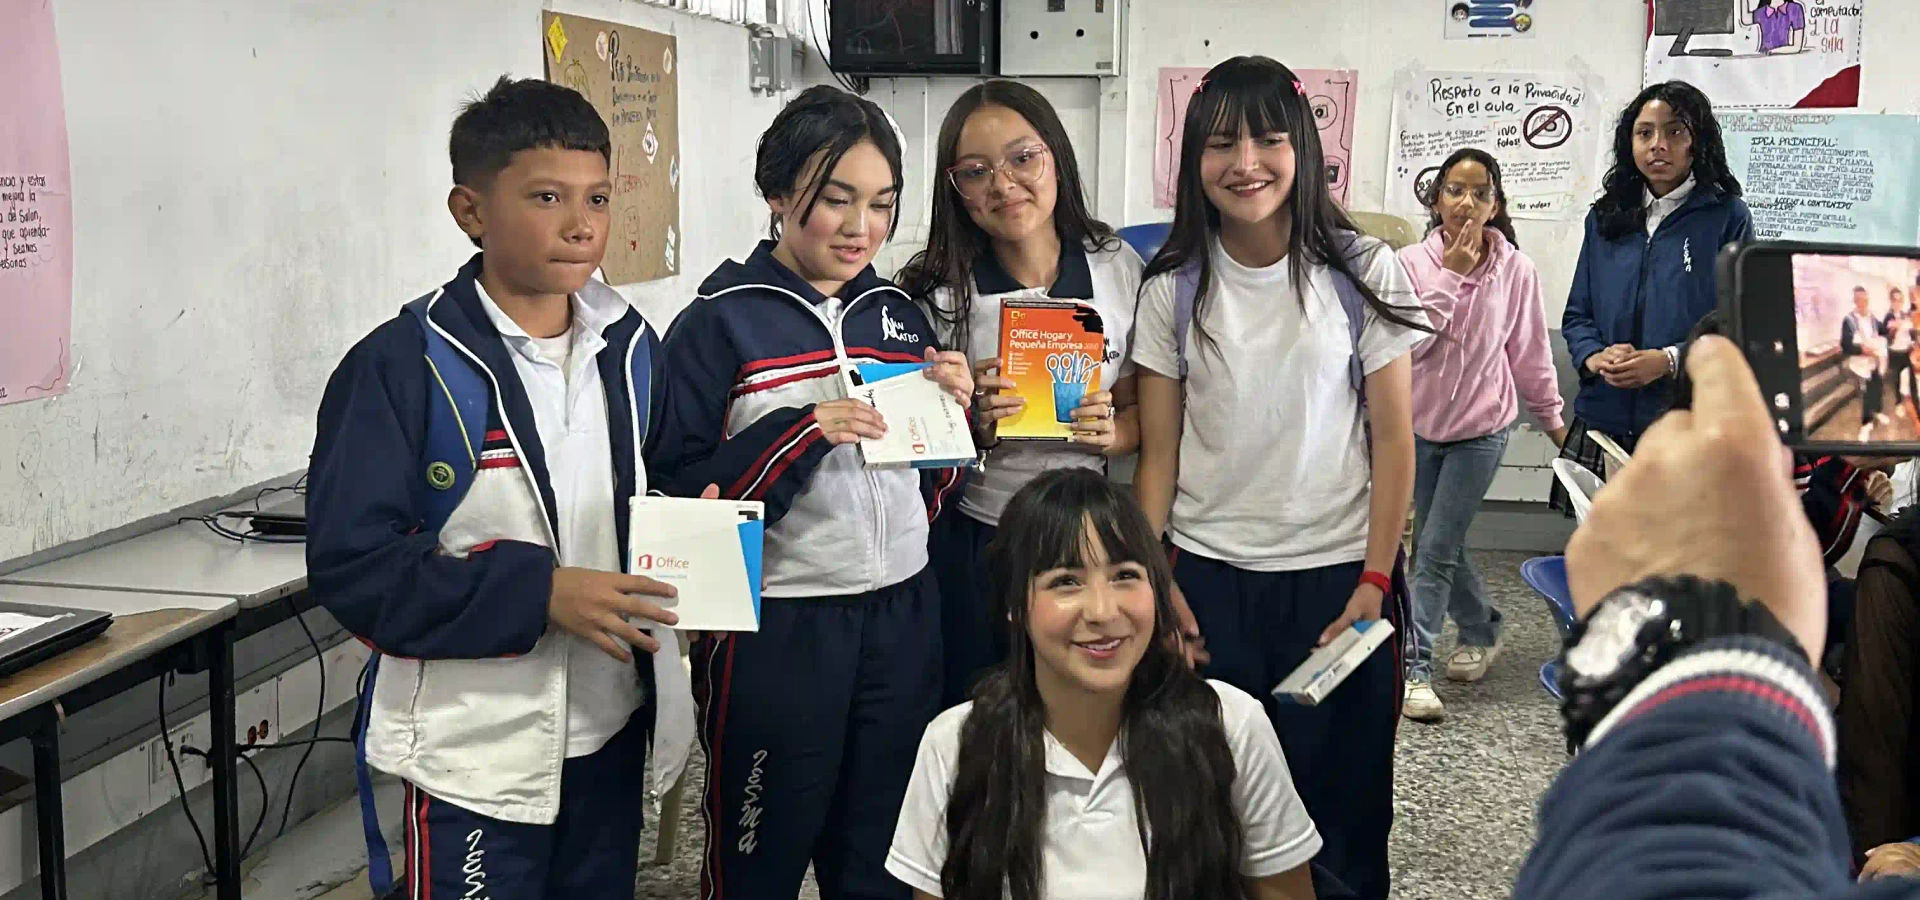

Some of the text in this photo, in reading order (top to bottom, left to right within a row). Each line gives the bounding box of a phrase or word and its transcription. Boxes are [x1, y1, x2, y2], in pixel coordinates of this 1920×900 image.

[1824, 17, 1839, 35] la
[1491, 86, 1500, 97] a
[1509, 84, 1520, 96] la
[1446, 100, 1514, 116] En el aula
[1751, 136, 1775, 146] IDEA
[29, 189, 36, 202] la
[1807, 199, 1853, 210] CONTENIDO
[1010, 328, 1039, 339] Office
[1040, 330, 1064, 341] Hogar
[1010, 340, 1046, 350] Pequeña
[1047, 340, 1083, 351] Empresa
[656, 556, 690, 569] Office
[462, 828, 487, 900] IES
